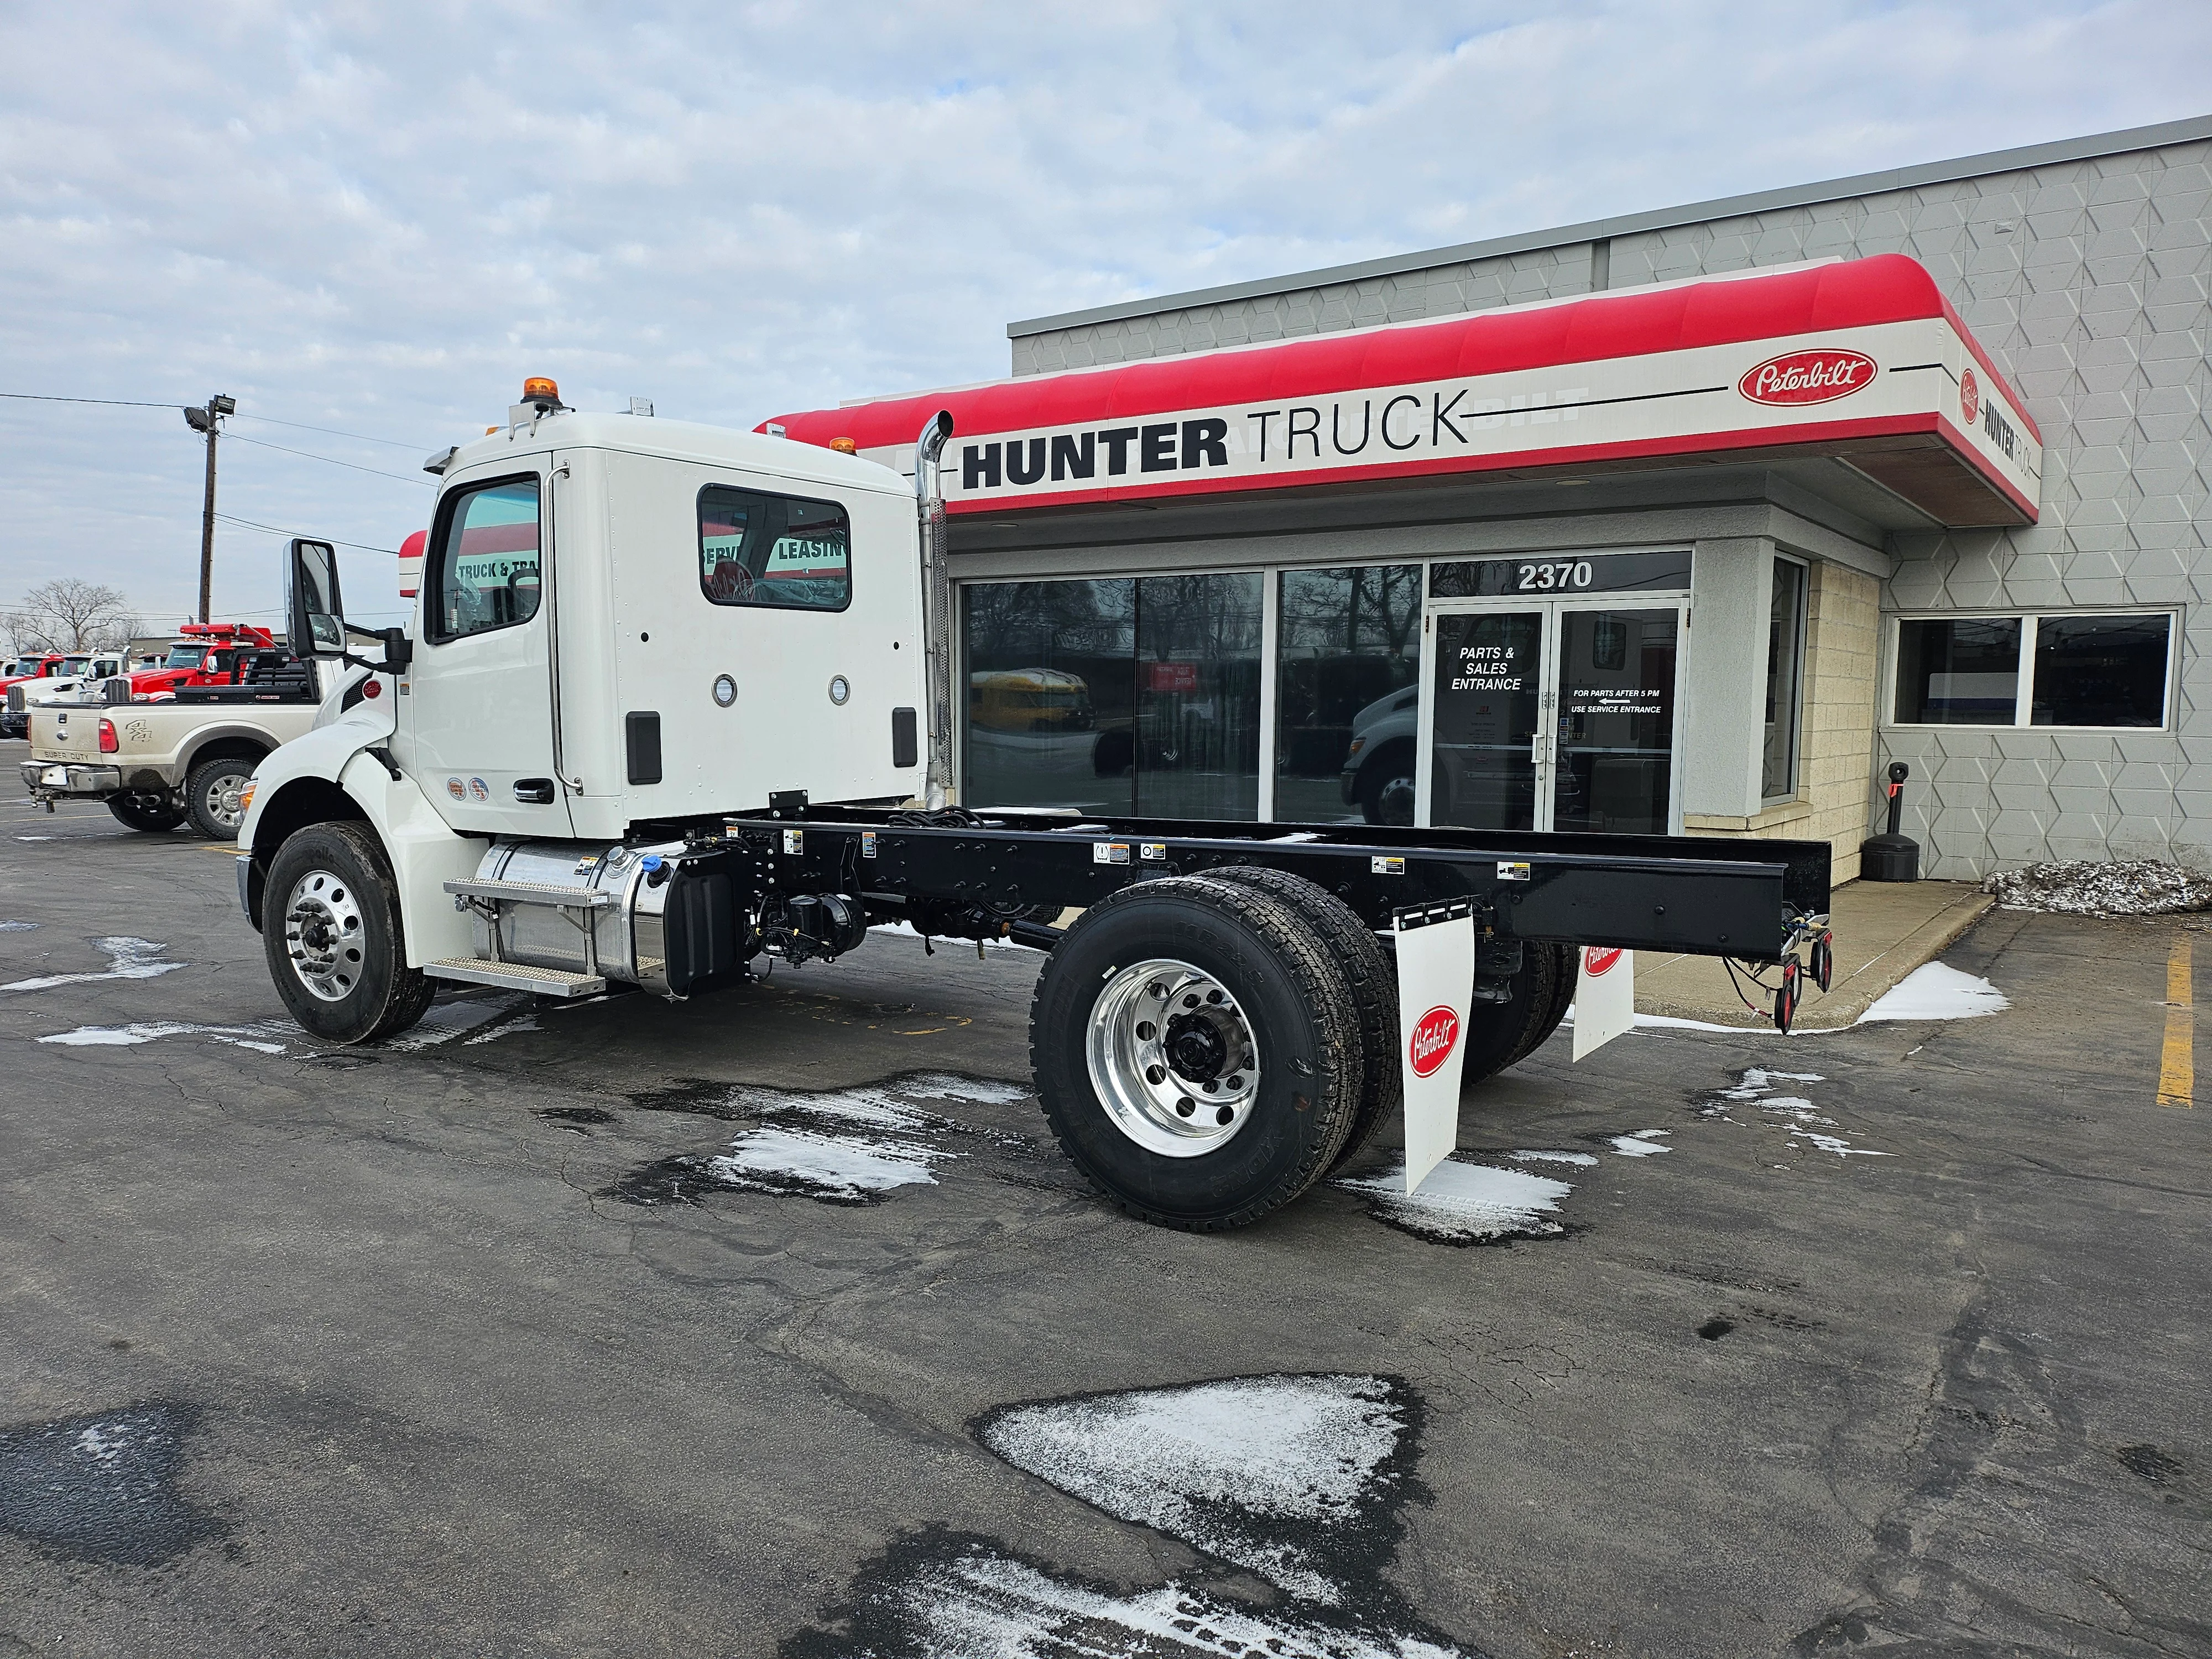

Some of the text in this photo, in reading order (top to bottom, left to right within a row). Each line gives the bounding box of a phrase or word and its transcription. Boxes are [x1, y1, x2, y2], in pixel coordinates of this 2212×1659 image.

[1756, 359, 1867, 397] Peterbilt
[963, 418, 1228, 490] HUNTER
[1248, 389, 1469, 462] TRUCK
[1984, 398, 2031, 480] HUNTER TRUCK
[458, 563, 497, 579] TRUCK
[500, 562, 509, 577] &
[1519, 562, 1592, 589] 2370
[1460, 647, 1515, 659] PARTS &
[1465, 663, 1508, 675] SALES
[1451, 678, 1522, 690] ENTRANCE
[71, 753, 89, 761] DUTY
[1414, 1018, 1455, 1066] Peterbilt
